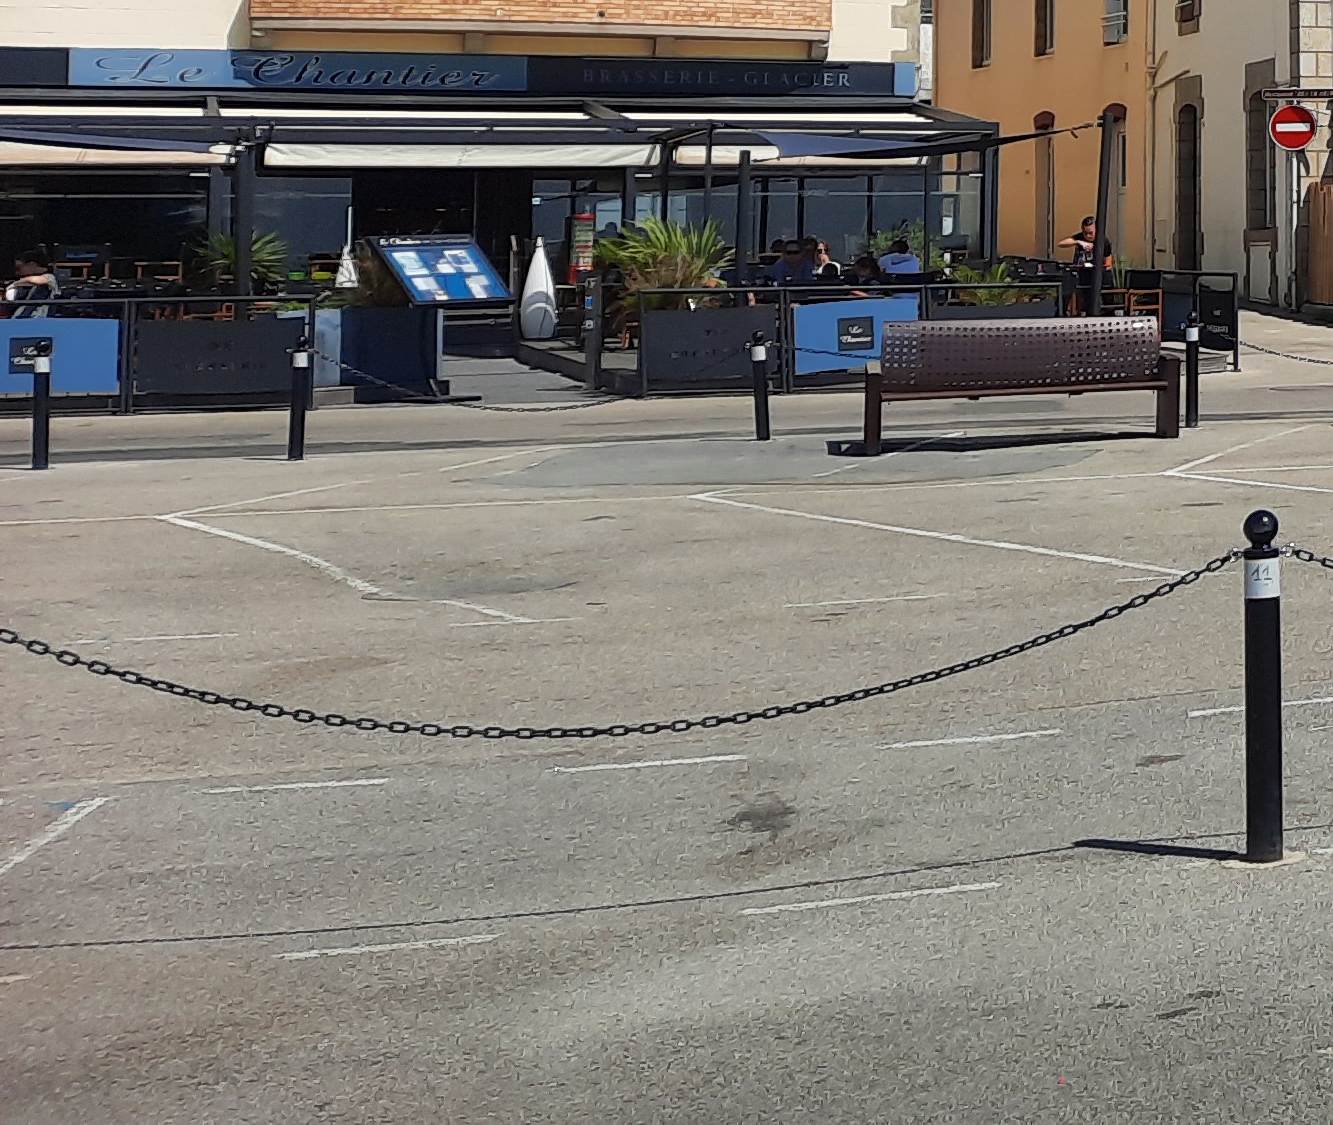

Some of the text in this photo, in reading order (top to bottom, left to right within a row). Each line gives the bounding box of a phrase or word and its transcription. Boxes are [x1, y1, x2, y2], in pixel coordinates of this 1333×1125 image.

[95, 53, 501, 87] Le Chantier
[582, 68, 720, 85] BRASSERIE
[744, 70, 851, 87] GLACIER
